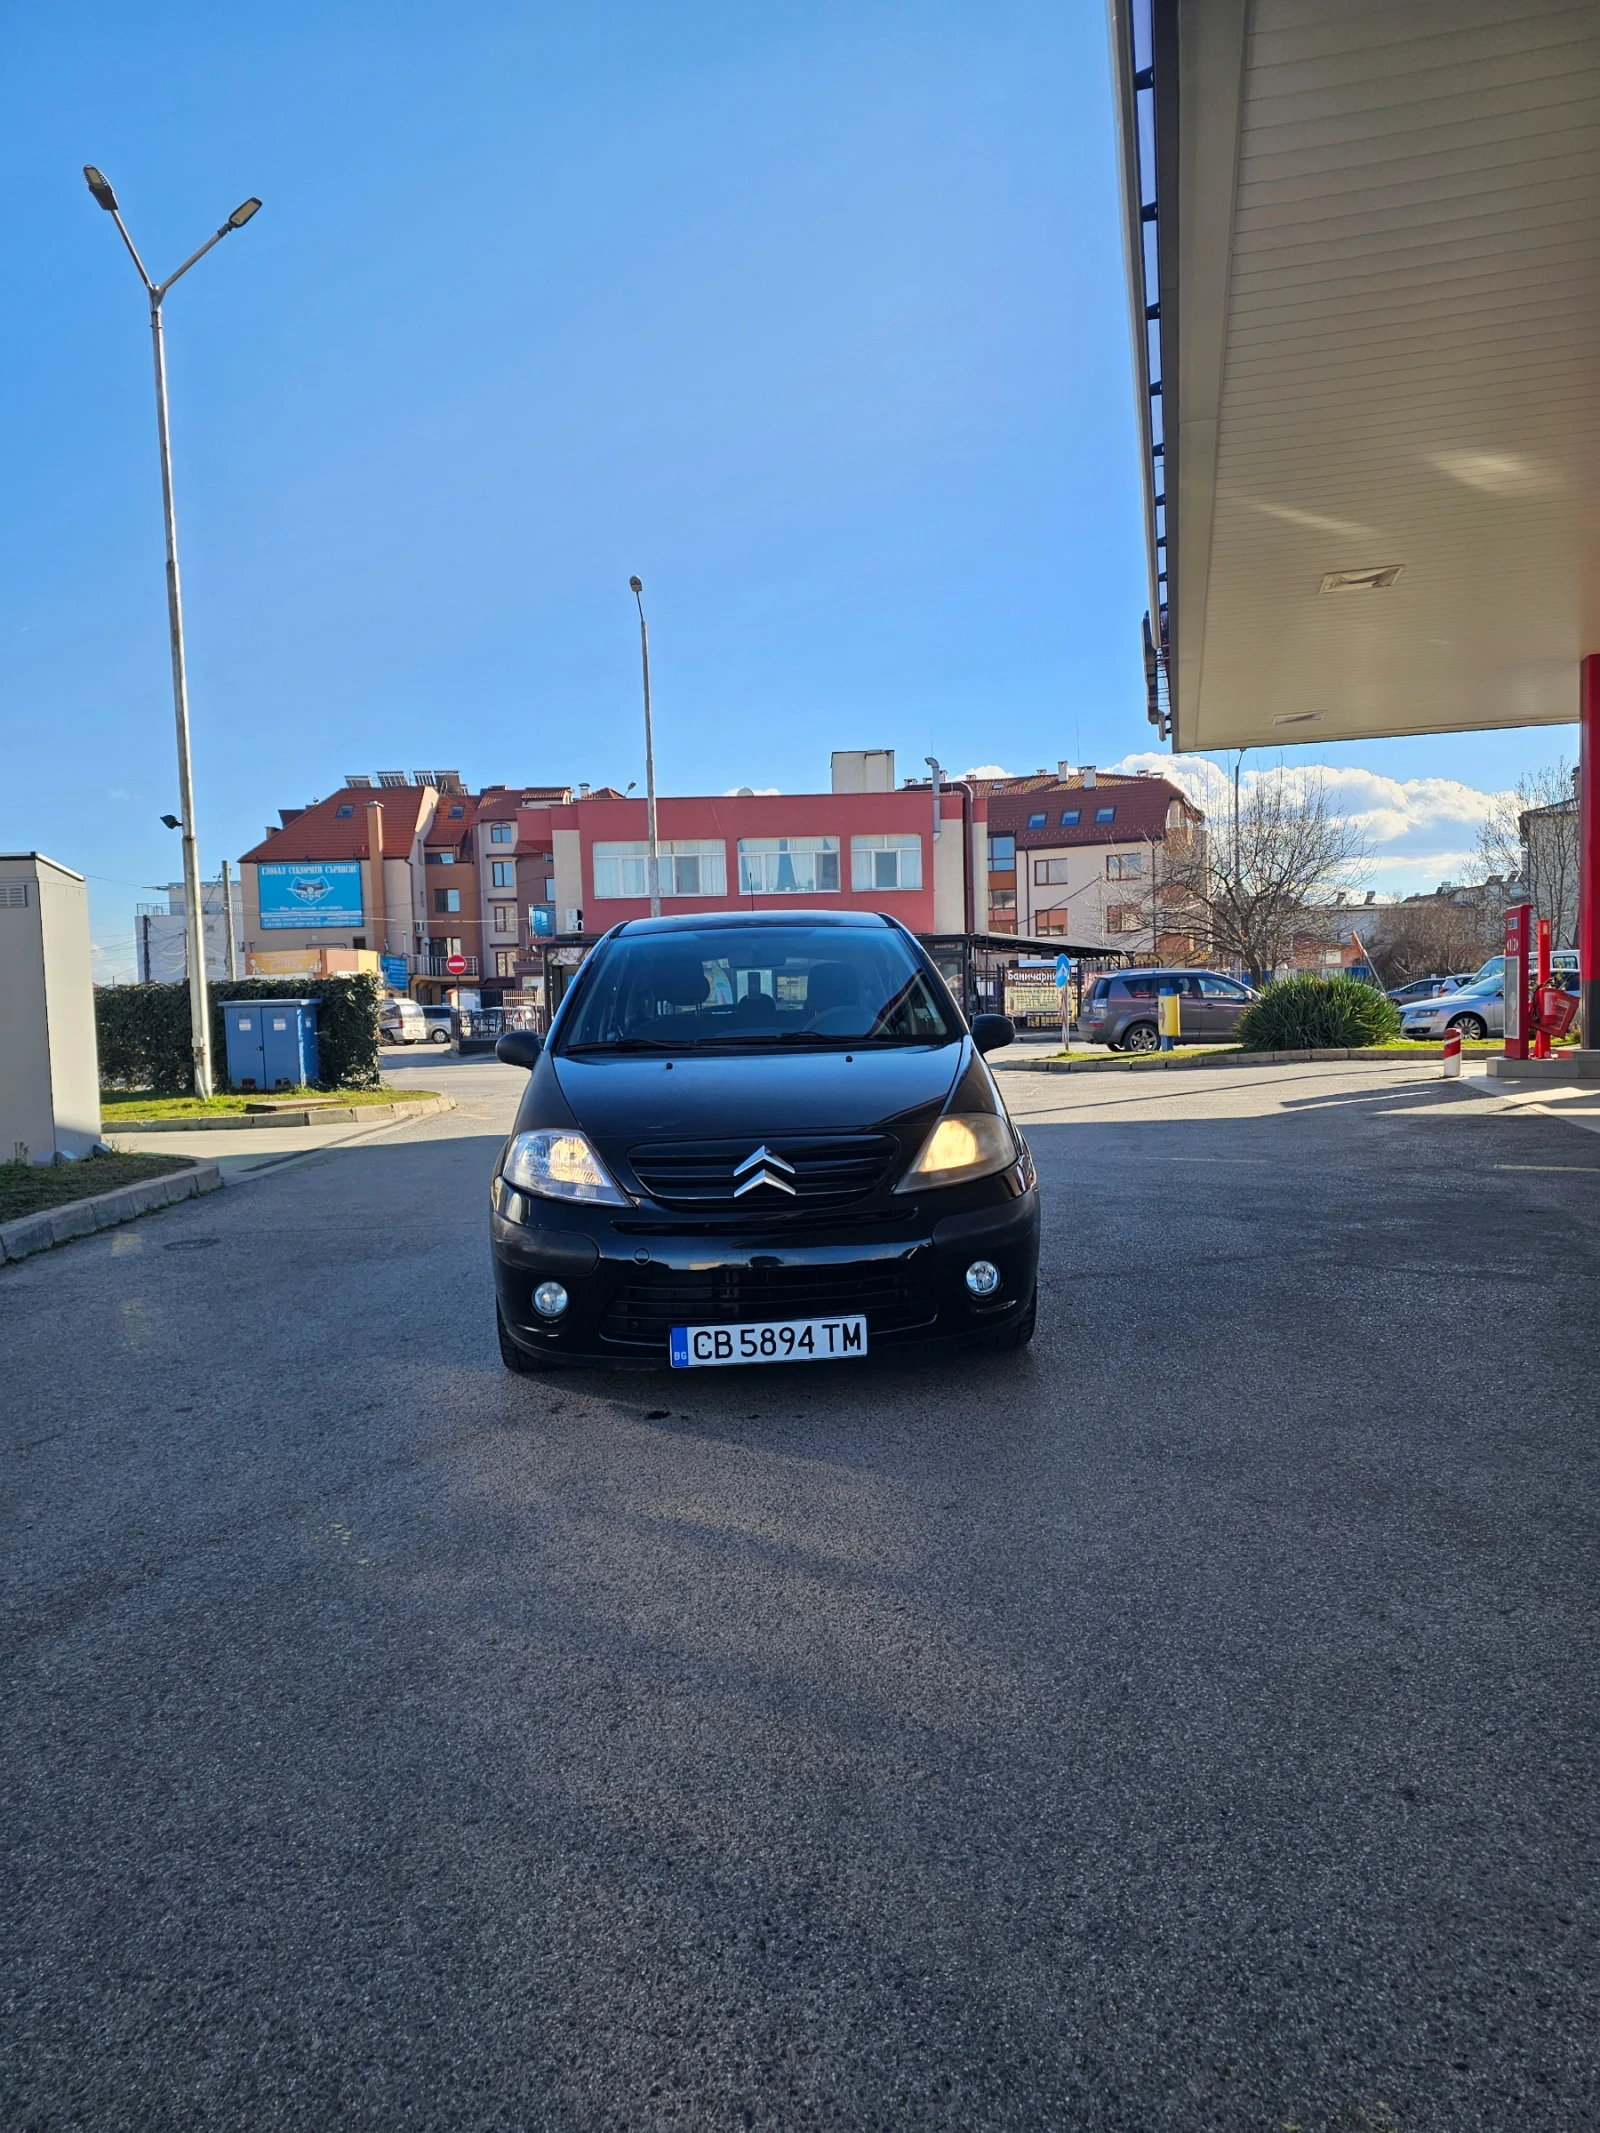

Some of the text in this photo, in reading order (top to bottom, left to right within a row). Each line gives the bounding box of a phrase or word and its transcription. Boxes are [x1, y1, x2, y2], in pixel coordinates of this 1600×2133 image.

[262, 866, 286, 875] ГЛОБАЛ
[288, 865, 323, 874] СЕКЮРИТИ
[674, 1322, 861, 1361] BG CB 5894 TM
